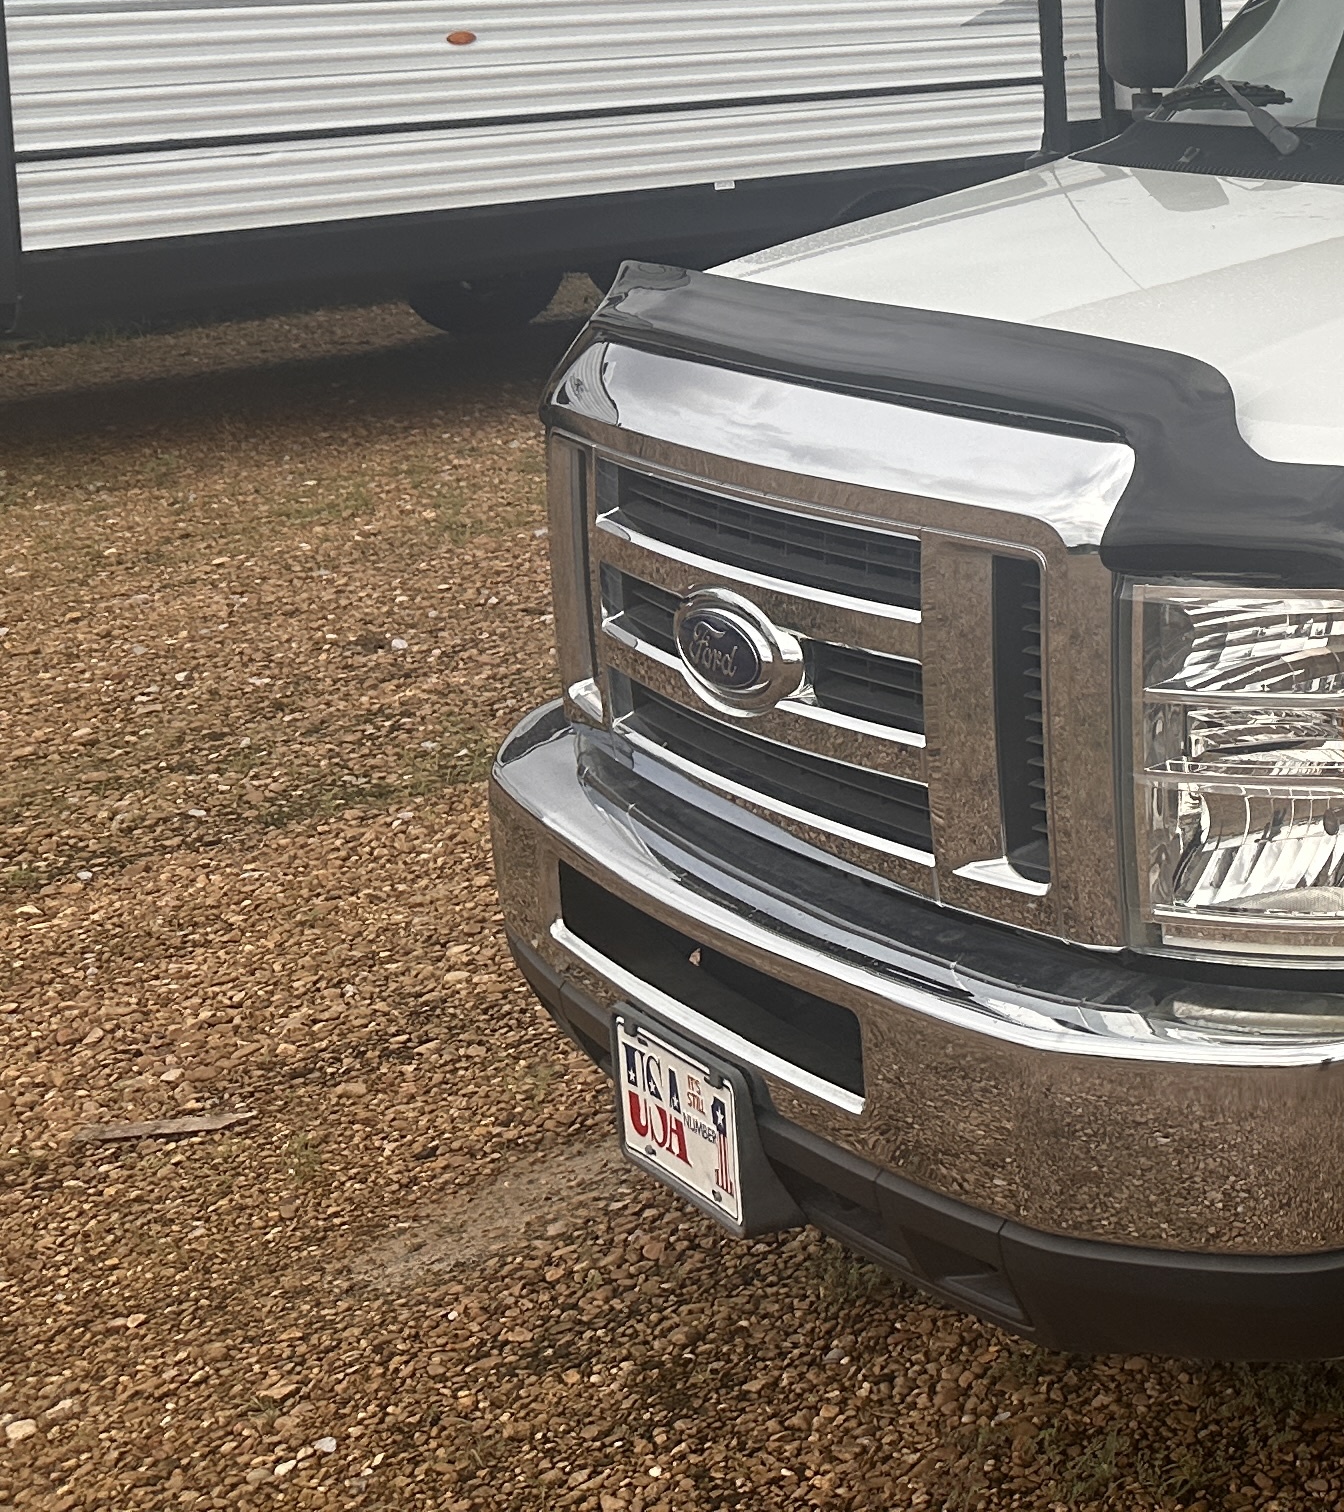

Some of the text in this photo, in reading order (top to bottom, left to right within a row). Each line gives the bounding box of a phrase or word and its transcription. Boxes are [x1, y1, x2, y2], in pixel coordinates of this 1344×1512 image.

[689, 620, 738, 678] Ford
[687, 1074, 701, 1095] IT'S
[686, 1092, 706, 1116] STILL
[683, 1111, 717, 1144] NUMBER
